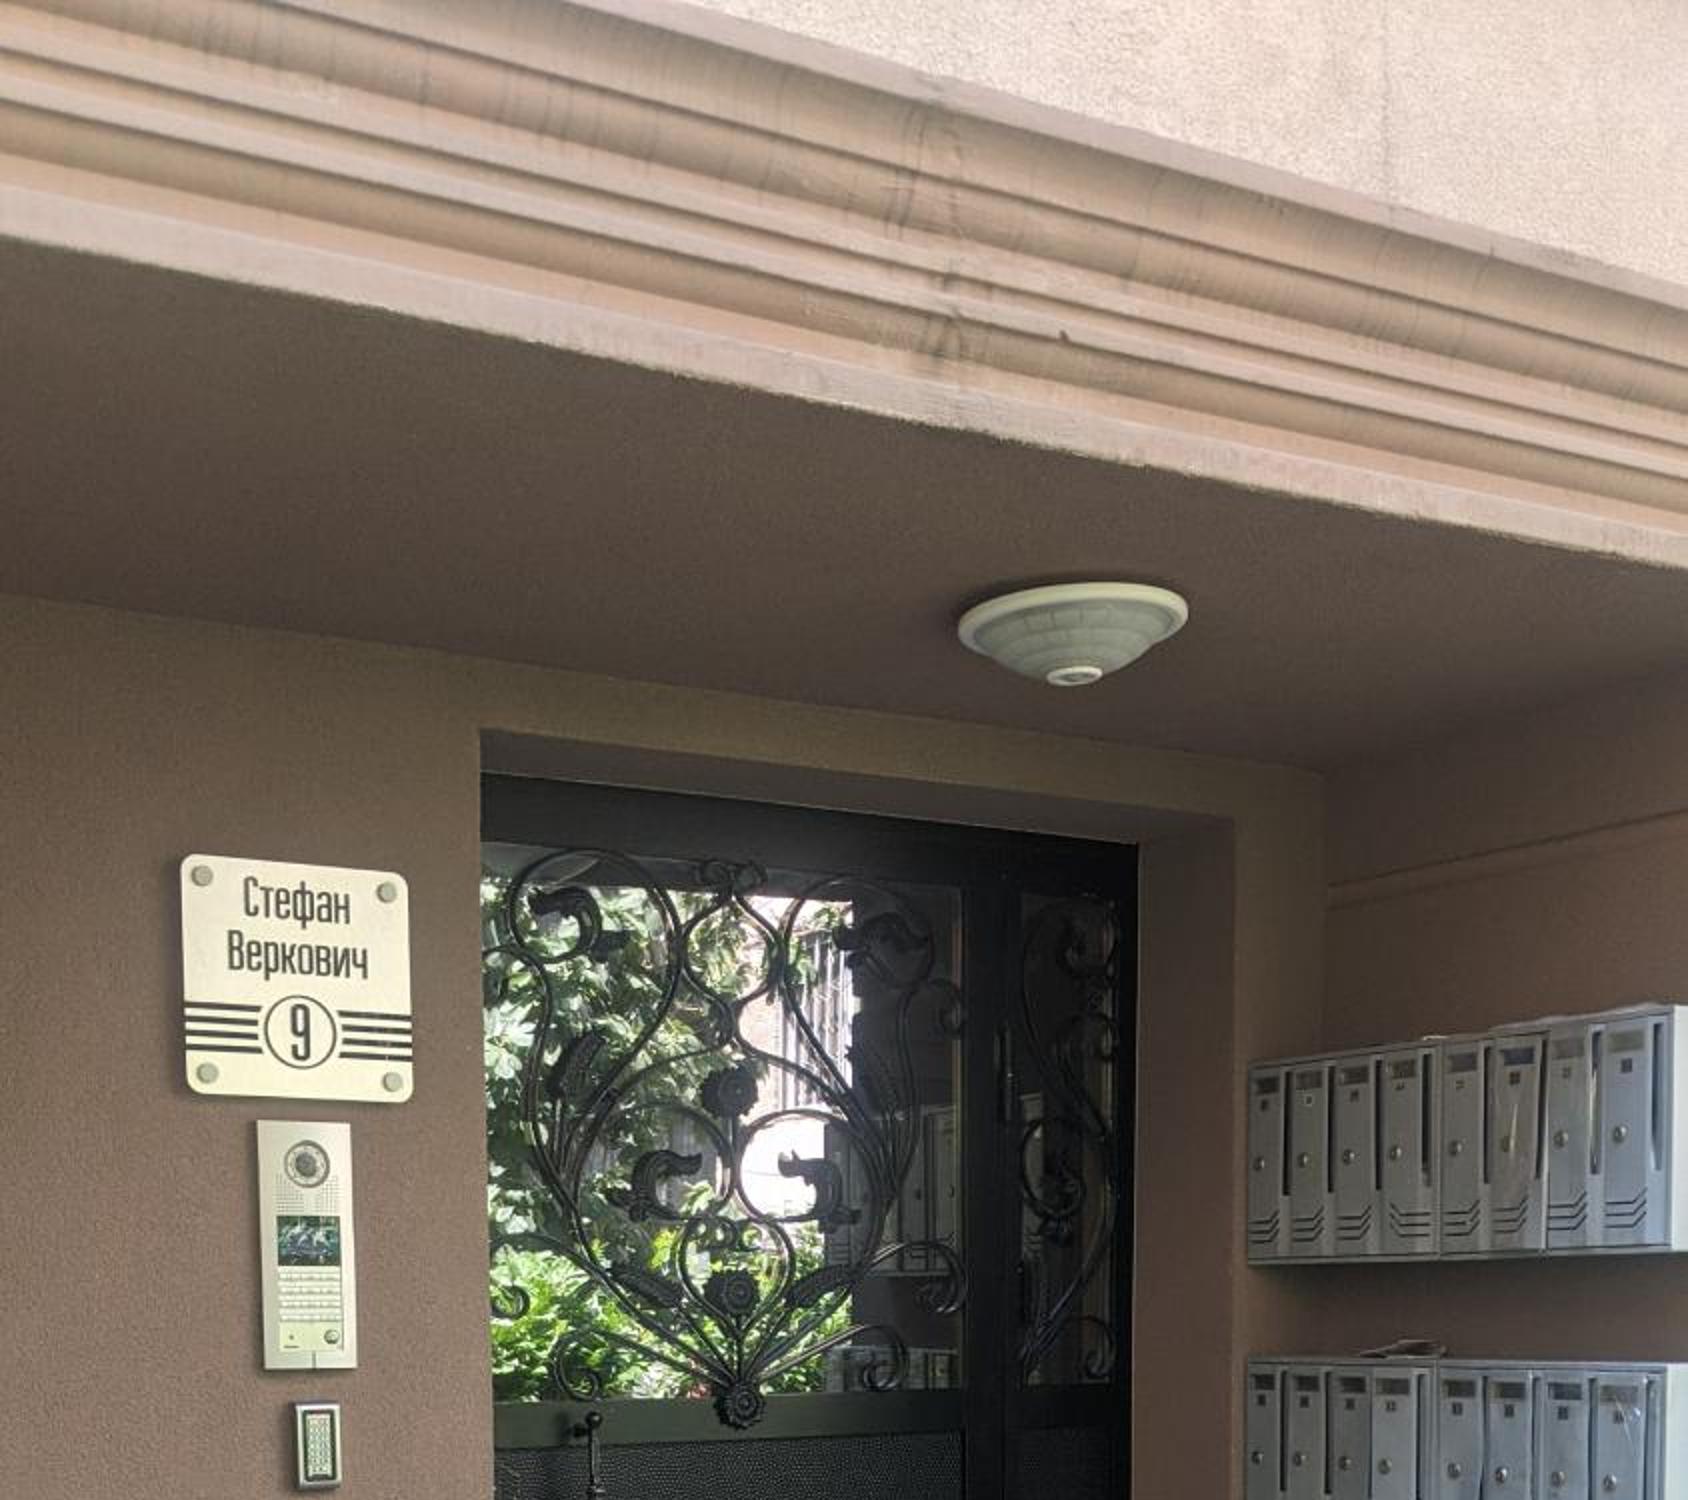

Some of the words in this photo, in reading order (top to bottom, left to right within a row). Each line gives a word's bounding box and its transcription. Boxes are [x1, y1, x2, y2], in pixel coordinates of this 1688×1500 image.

[243, 875, 351, 929] Стефан
[227, 929, 369, 981] Веркович
[290, 1003, 310, 1061] 9
